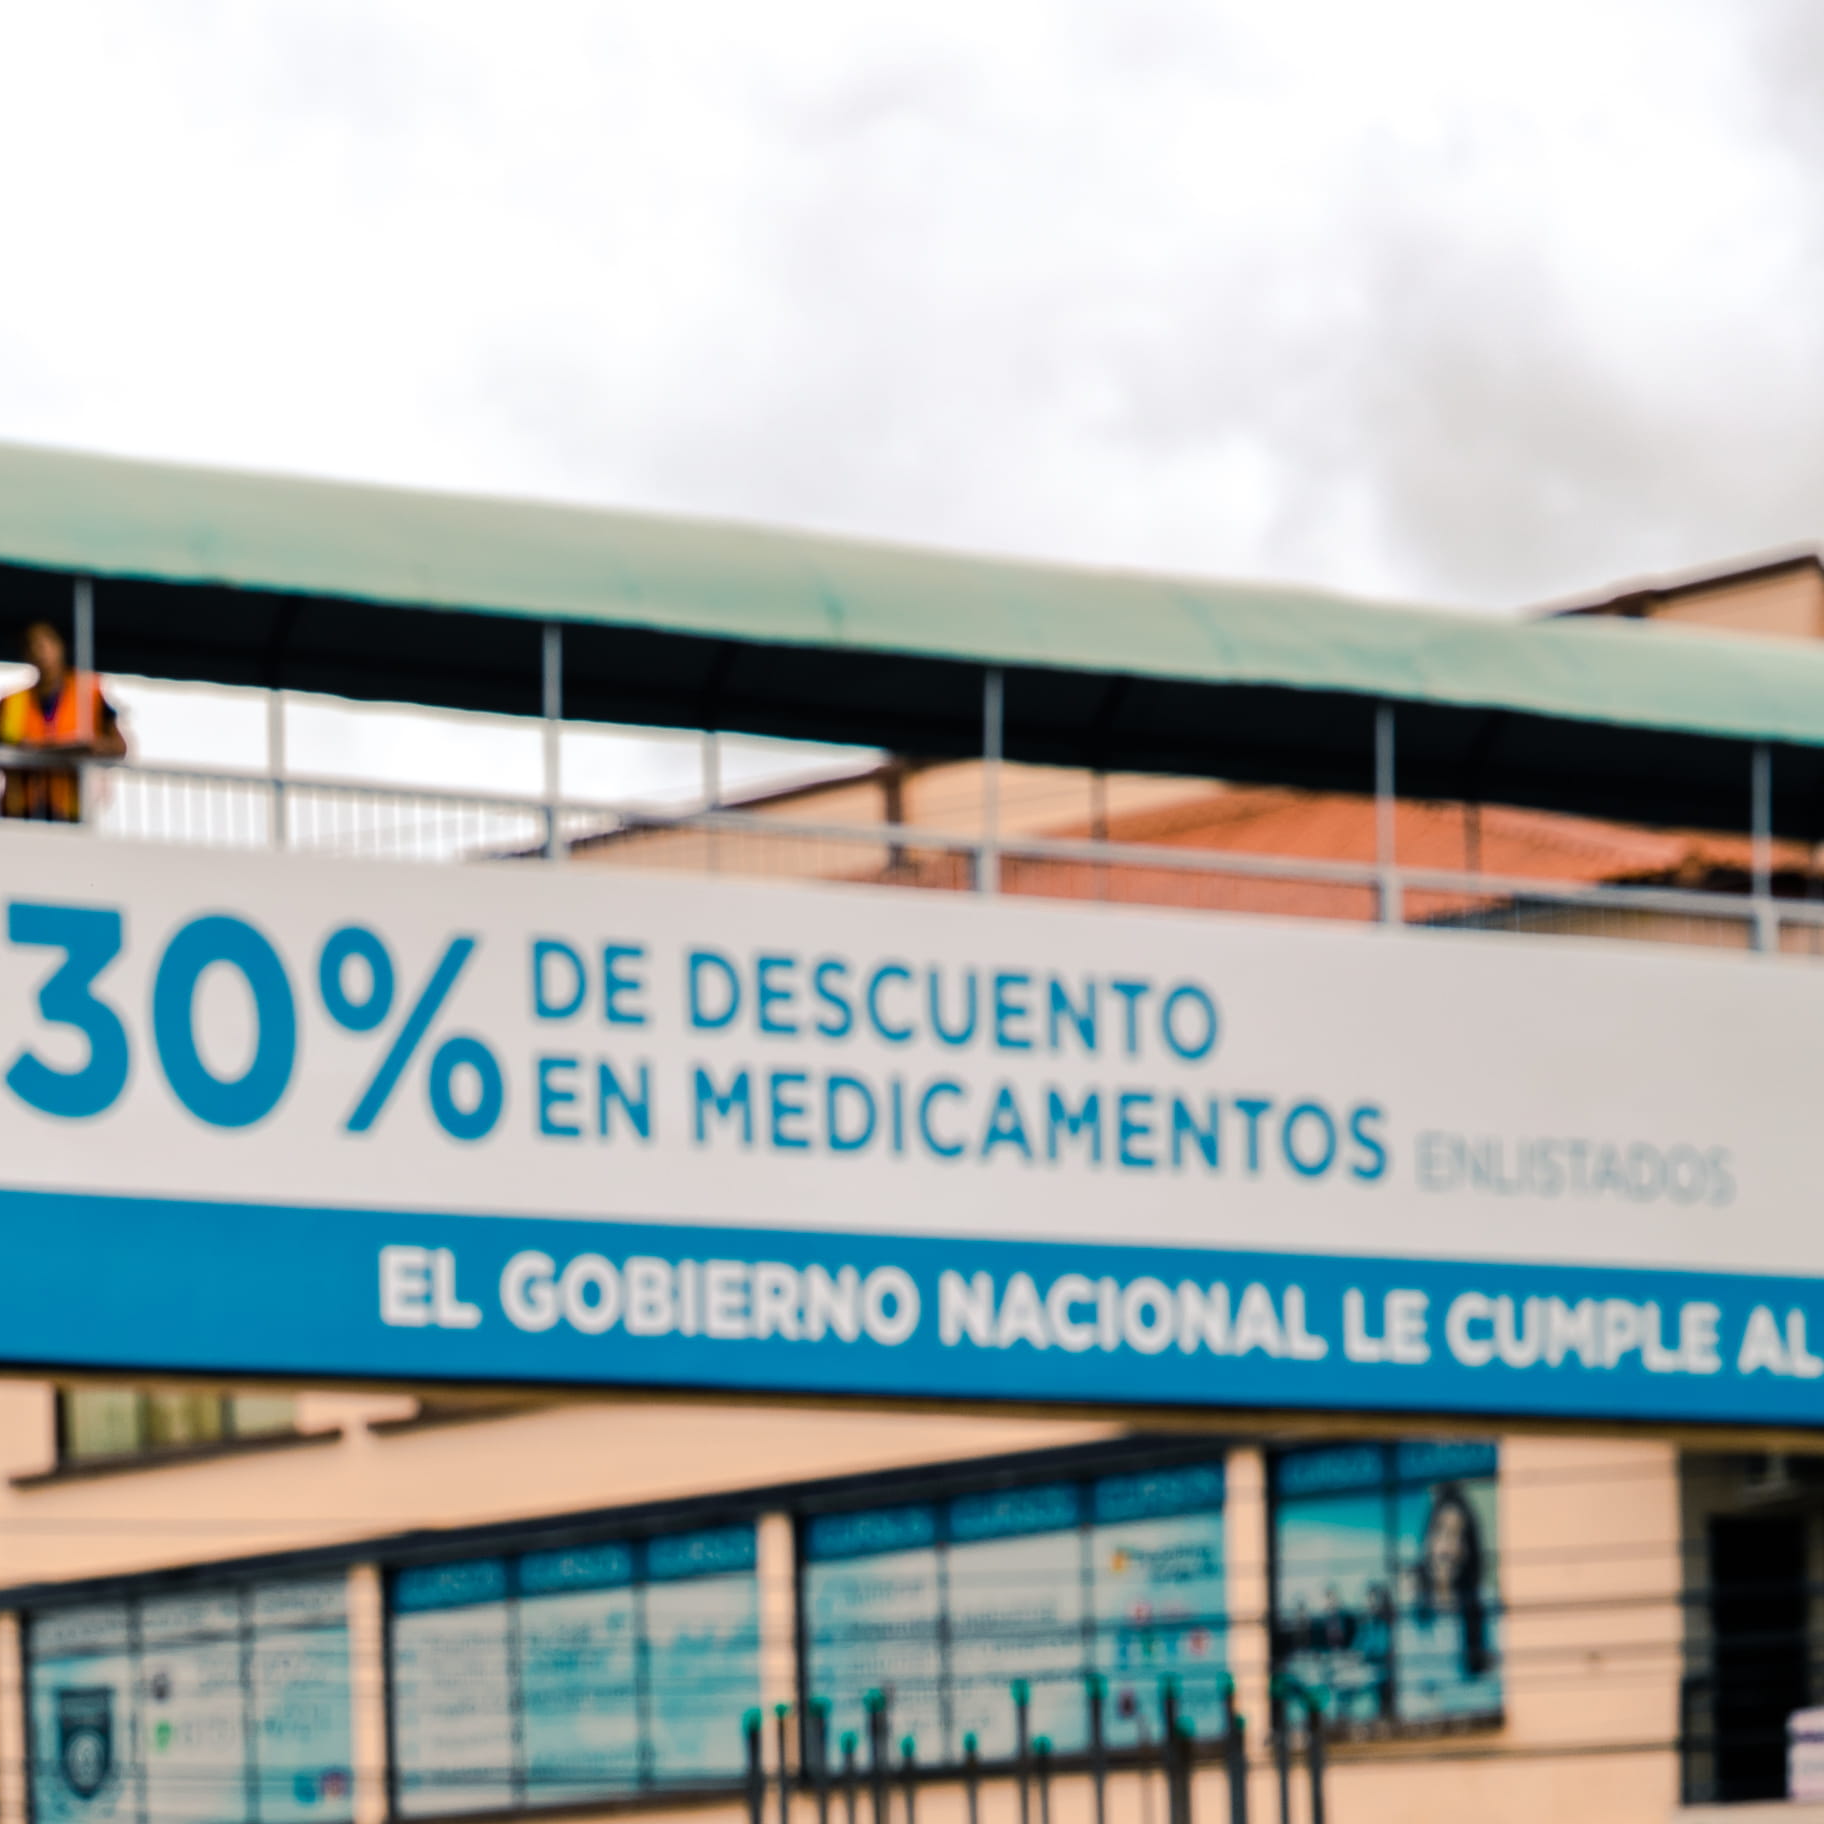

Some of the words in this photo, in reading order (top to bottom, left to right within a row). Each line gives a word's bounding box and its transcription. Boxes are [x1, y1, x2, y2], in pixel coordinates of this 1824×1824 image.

[1, 898, 506, 1143] 30%
[529, 936, 648, 1027] DE
[684, 947, 1220, 1064] DESCUENTO
[534, 1055, 654, 1141] EN
[690, 1065, 1389, 1183] MEDICAMENTOS
[1416, 1131, 1735, 1207] ENLISTADOS
[377, 1243, 483, 1330] EL
[497, 1249, 922, 1347] GOBIERNO
[937, 1269, 1329, 1361] NACIONAL
[1342, 1286, 1431, 1366] LE
[1444, 1291, 1722, 1376] CUMPLE
[1737, 1304, 1824, 1380] AL
